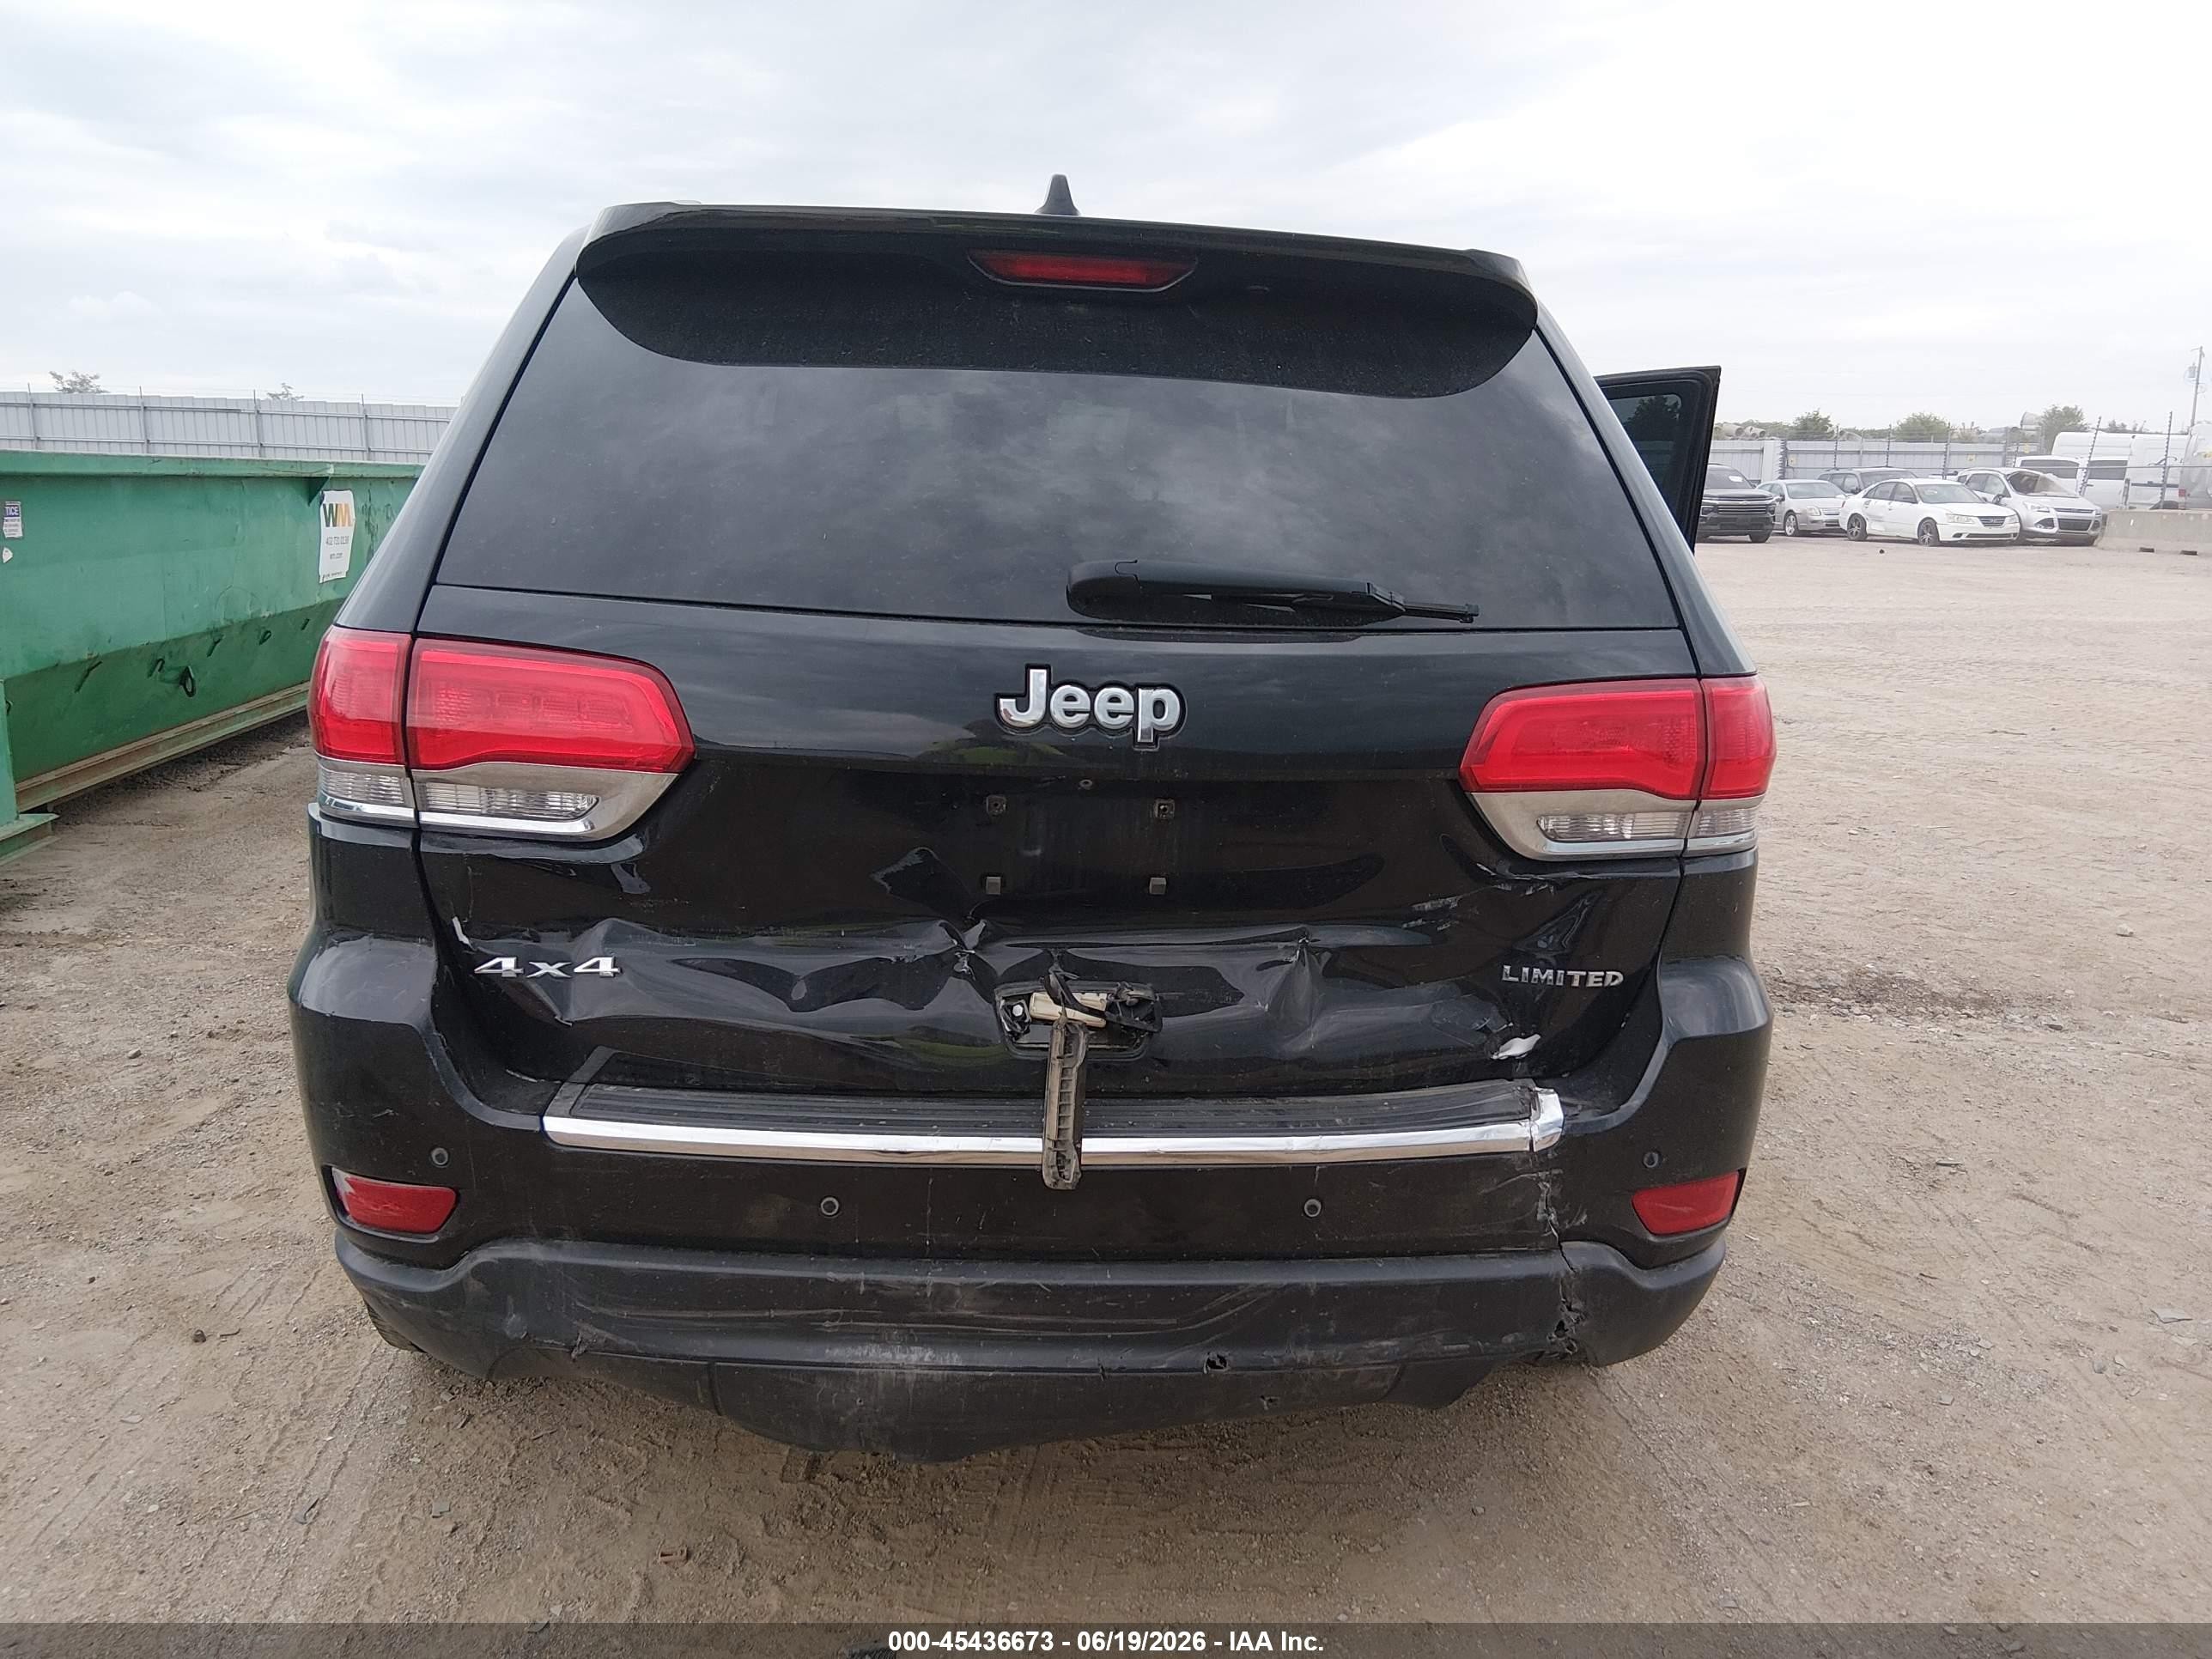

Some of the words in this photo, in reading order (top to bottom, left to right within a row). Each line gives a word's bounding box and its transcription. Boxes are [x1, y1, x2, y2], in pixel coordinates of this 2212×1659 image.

[5, 507, 19, 516] TICE
[323, 503, 352, 527] WM
[1000, 669, 1181, 743] Jeep
[474, 957, 622, 978] 4x4
[1502, 964, 1624, 987] LIMITED
